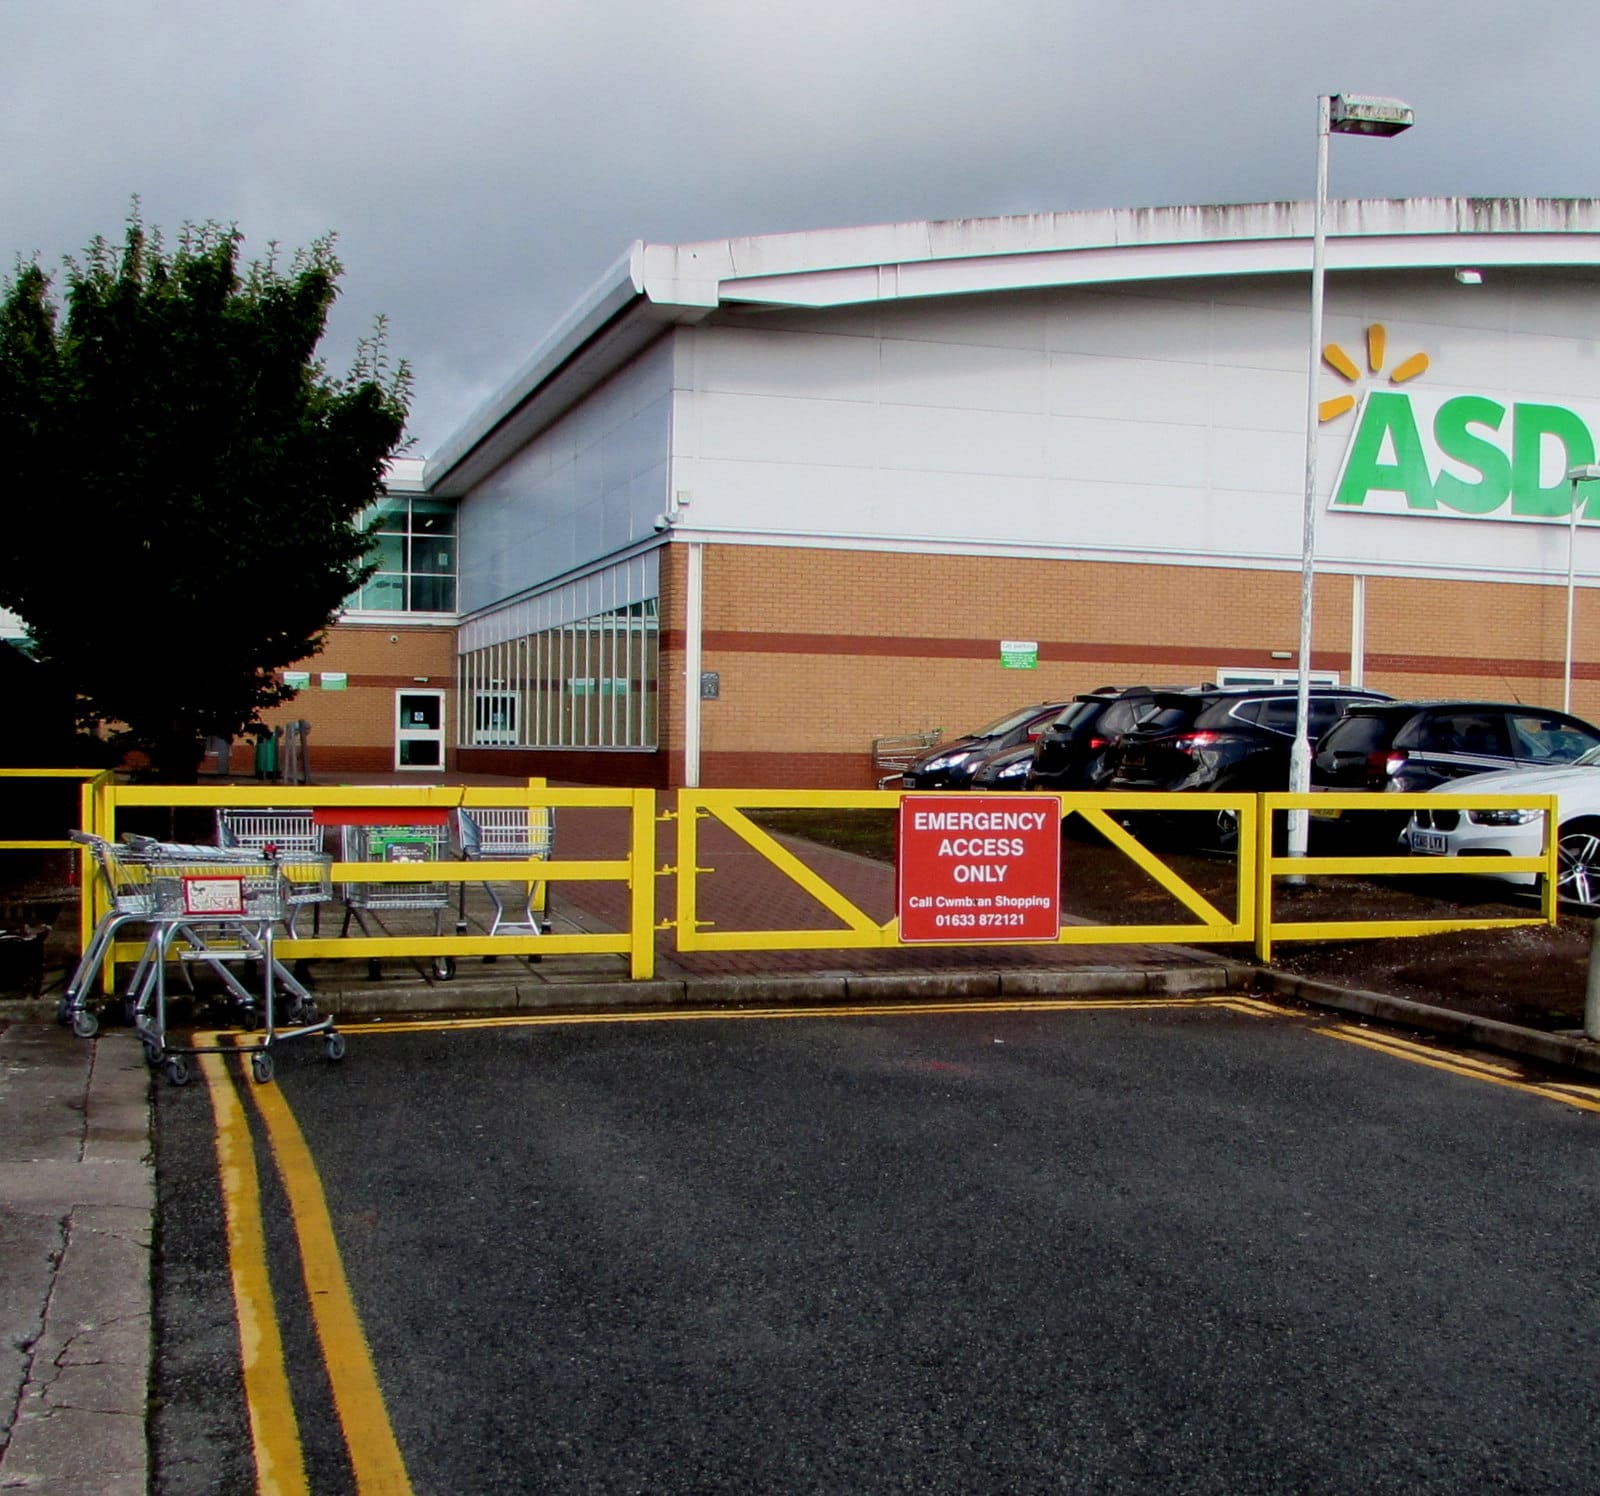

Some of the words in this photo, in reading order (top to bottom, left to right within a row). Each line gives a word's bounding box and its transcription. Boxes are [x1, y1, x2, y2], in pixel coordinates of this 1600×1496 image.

[1333, 390, 1600, 519] ASD
[914, 812, 1046, 830] EMERGENCY
[938, 839, 1024, 856] ACCESS
[953, 865, 1008, 883] ONLY
[909, 896, 932, 907] Call
[995, 895, 1050, 909] Shopping
[935, 914, 975, 926] 01633
[979, 914, 1024, 925] 872121
